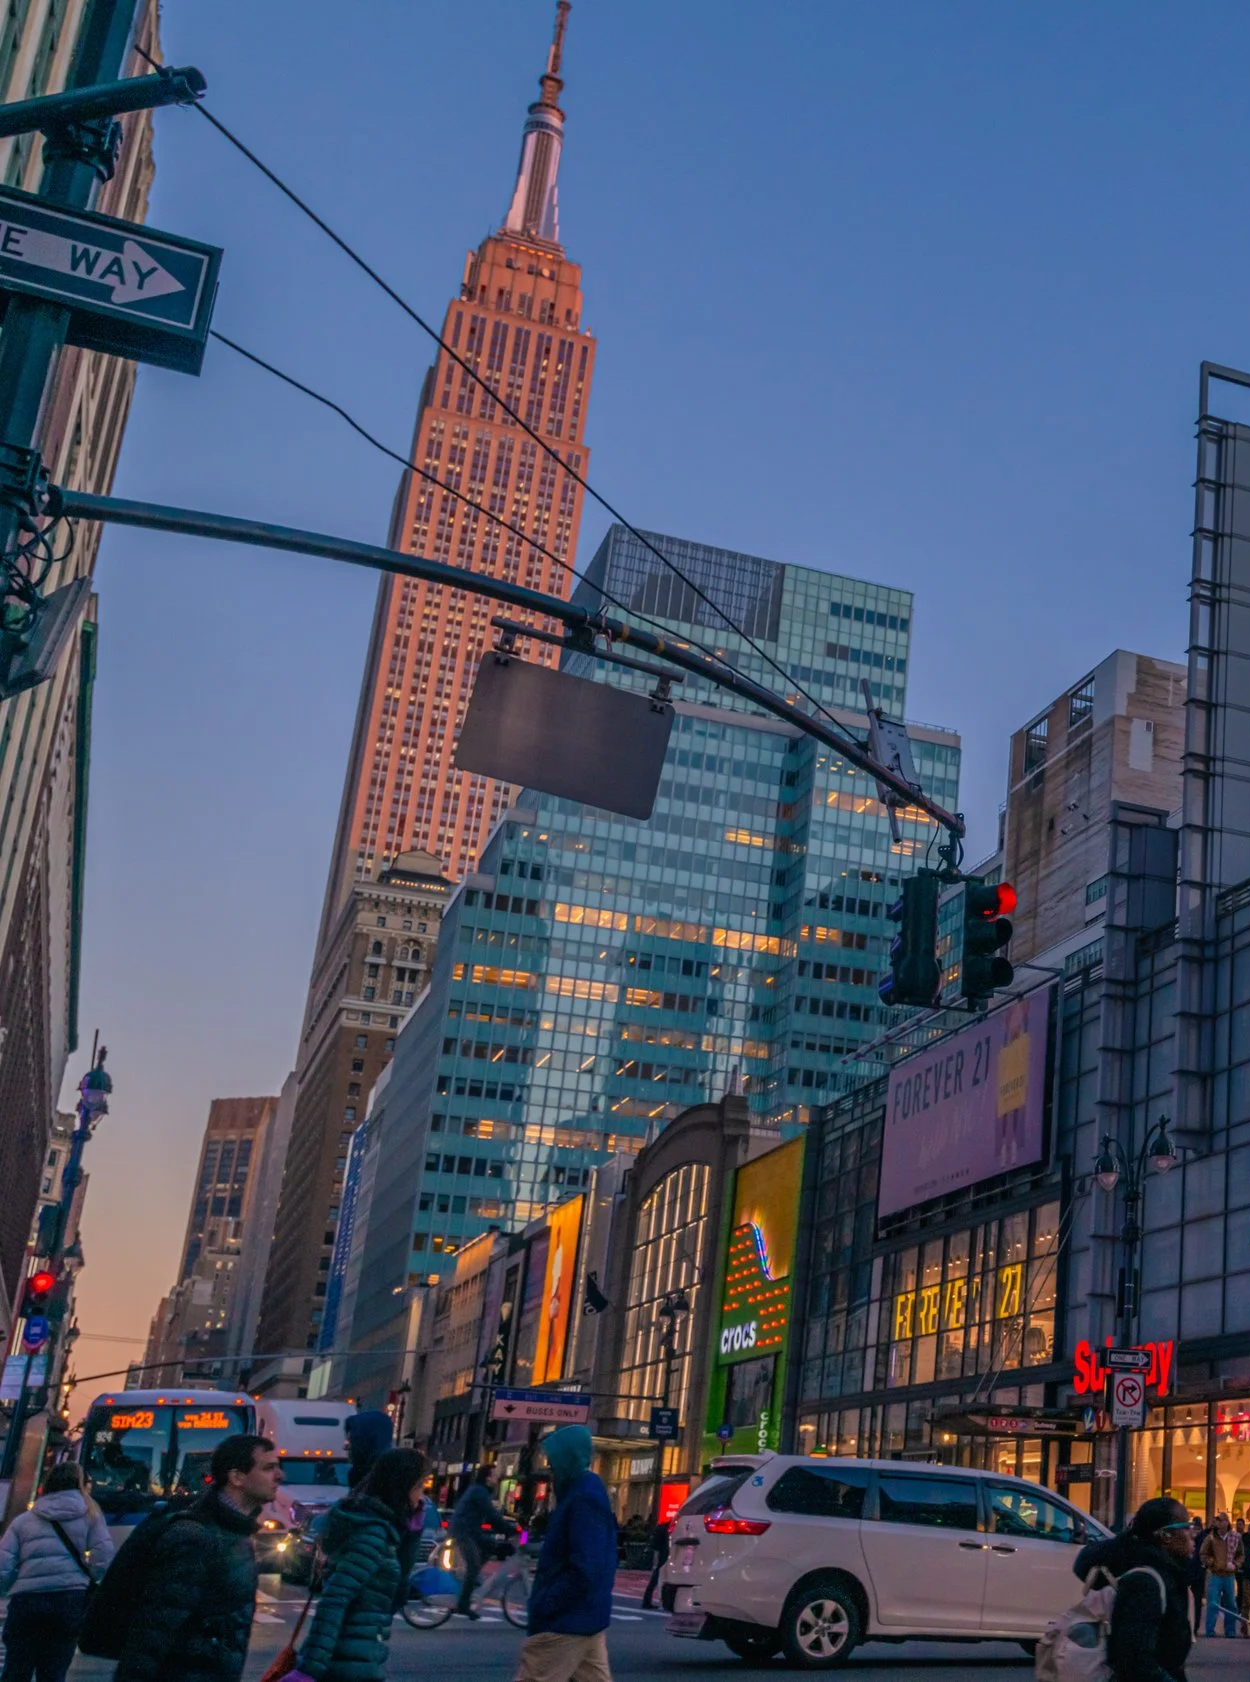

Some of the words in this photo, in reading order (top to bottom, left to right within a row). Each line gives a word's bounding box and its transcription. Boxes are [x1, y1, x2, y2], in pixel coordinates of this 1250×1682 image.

[69, 244, 158, 290] WAY
[892, 1049, 965, 1125] FOREVER
[971, 1035, 992, 1088] 21
[999, 1263, 1022, 1319] 21
[721, 1320, 758, 1355] crocs
[111, 1411, 155, 1429] SIM23
[526, 1407, 554, 1417] BUSES
[557, 1408, 579, 1418] ONLY
[1033, 1421, 1057, 1430] Subway
